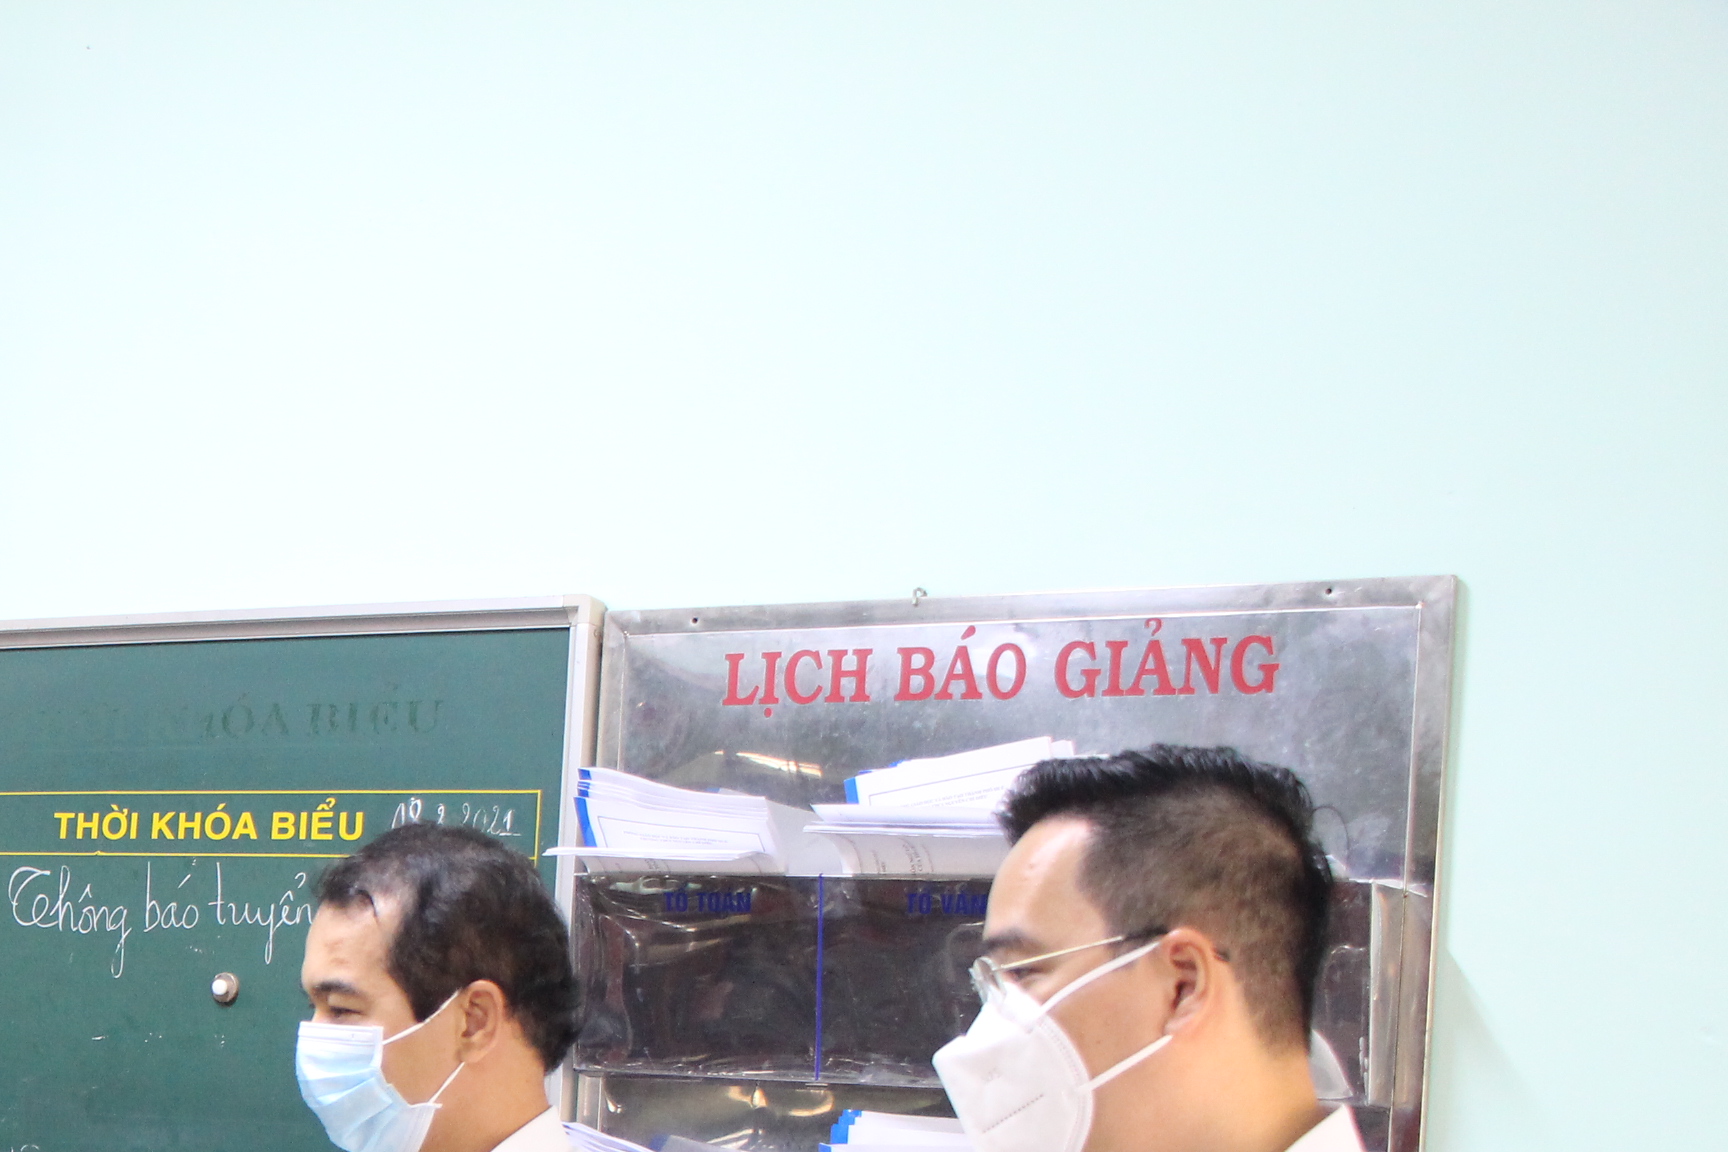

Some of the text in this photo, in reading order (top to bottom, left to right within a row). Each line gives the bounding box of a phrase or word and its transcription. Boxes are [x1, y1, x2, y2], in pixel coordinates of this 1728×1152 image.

[723, 618, 1280, 718] LỊCH BÁO GIẢNG
[53, 797, 365, 841] THỜI KHÓA BIỂU
[8, 865, 132, 978] Thông
[143, 860, 199, 932] báo
